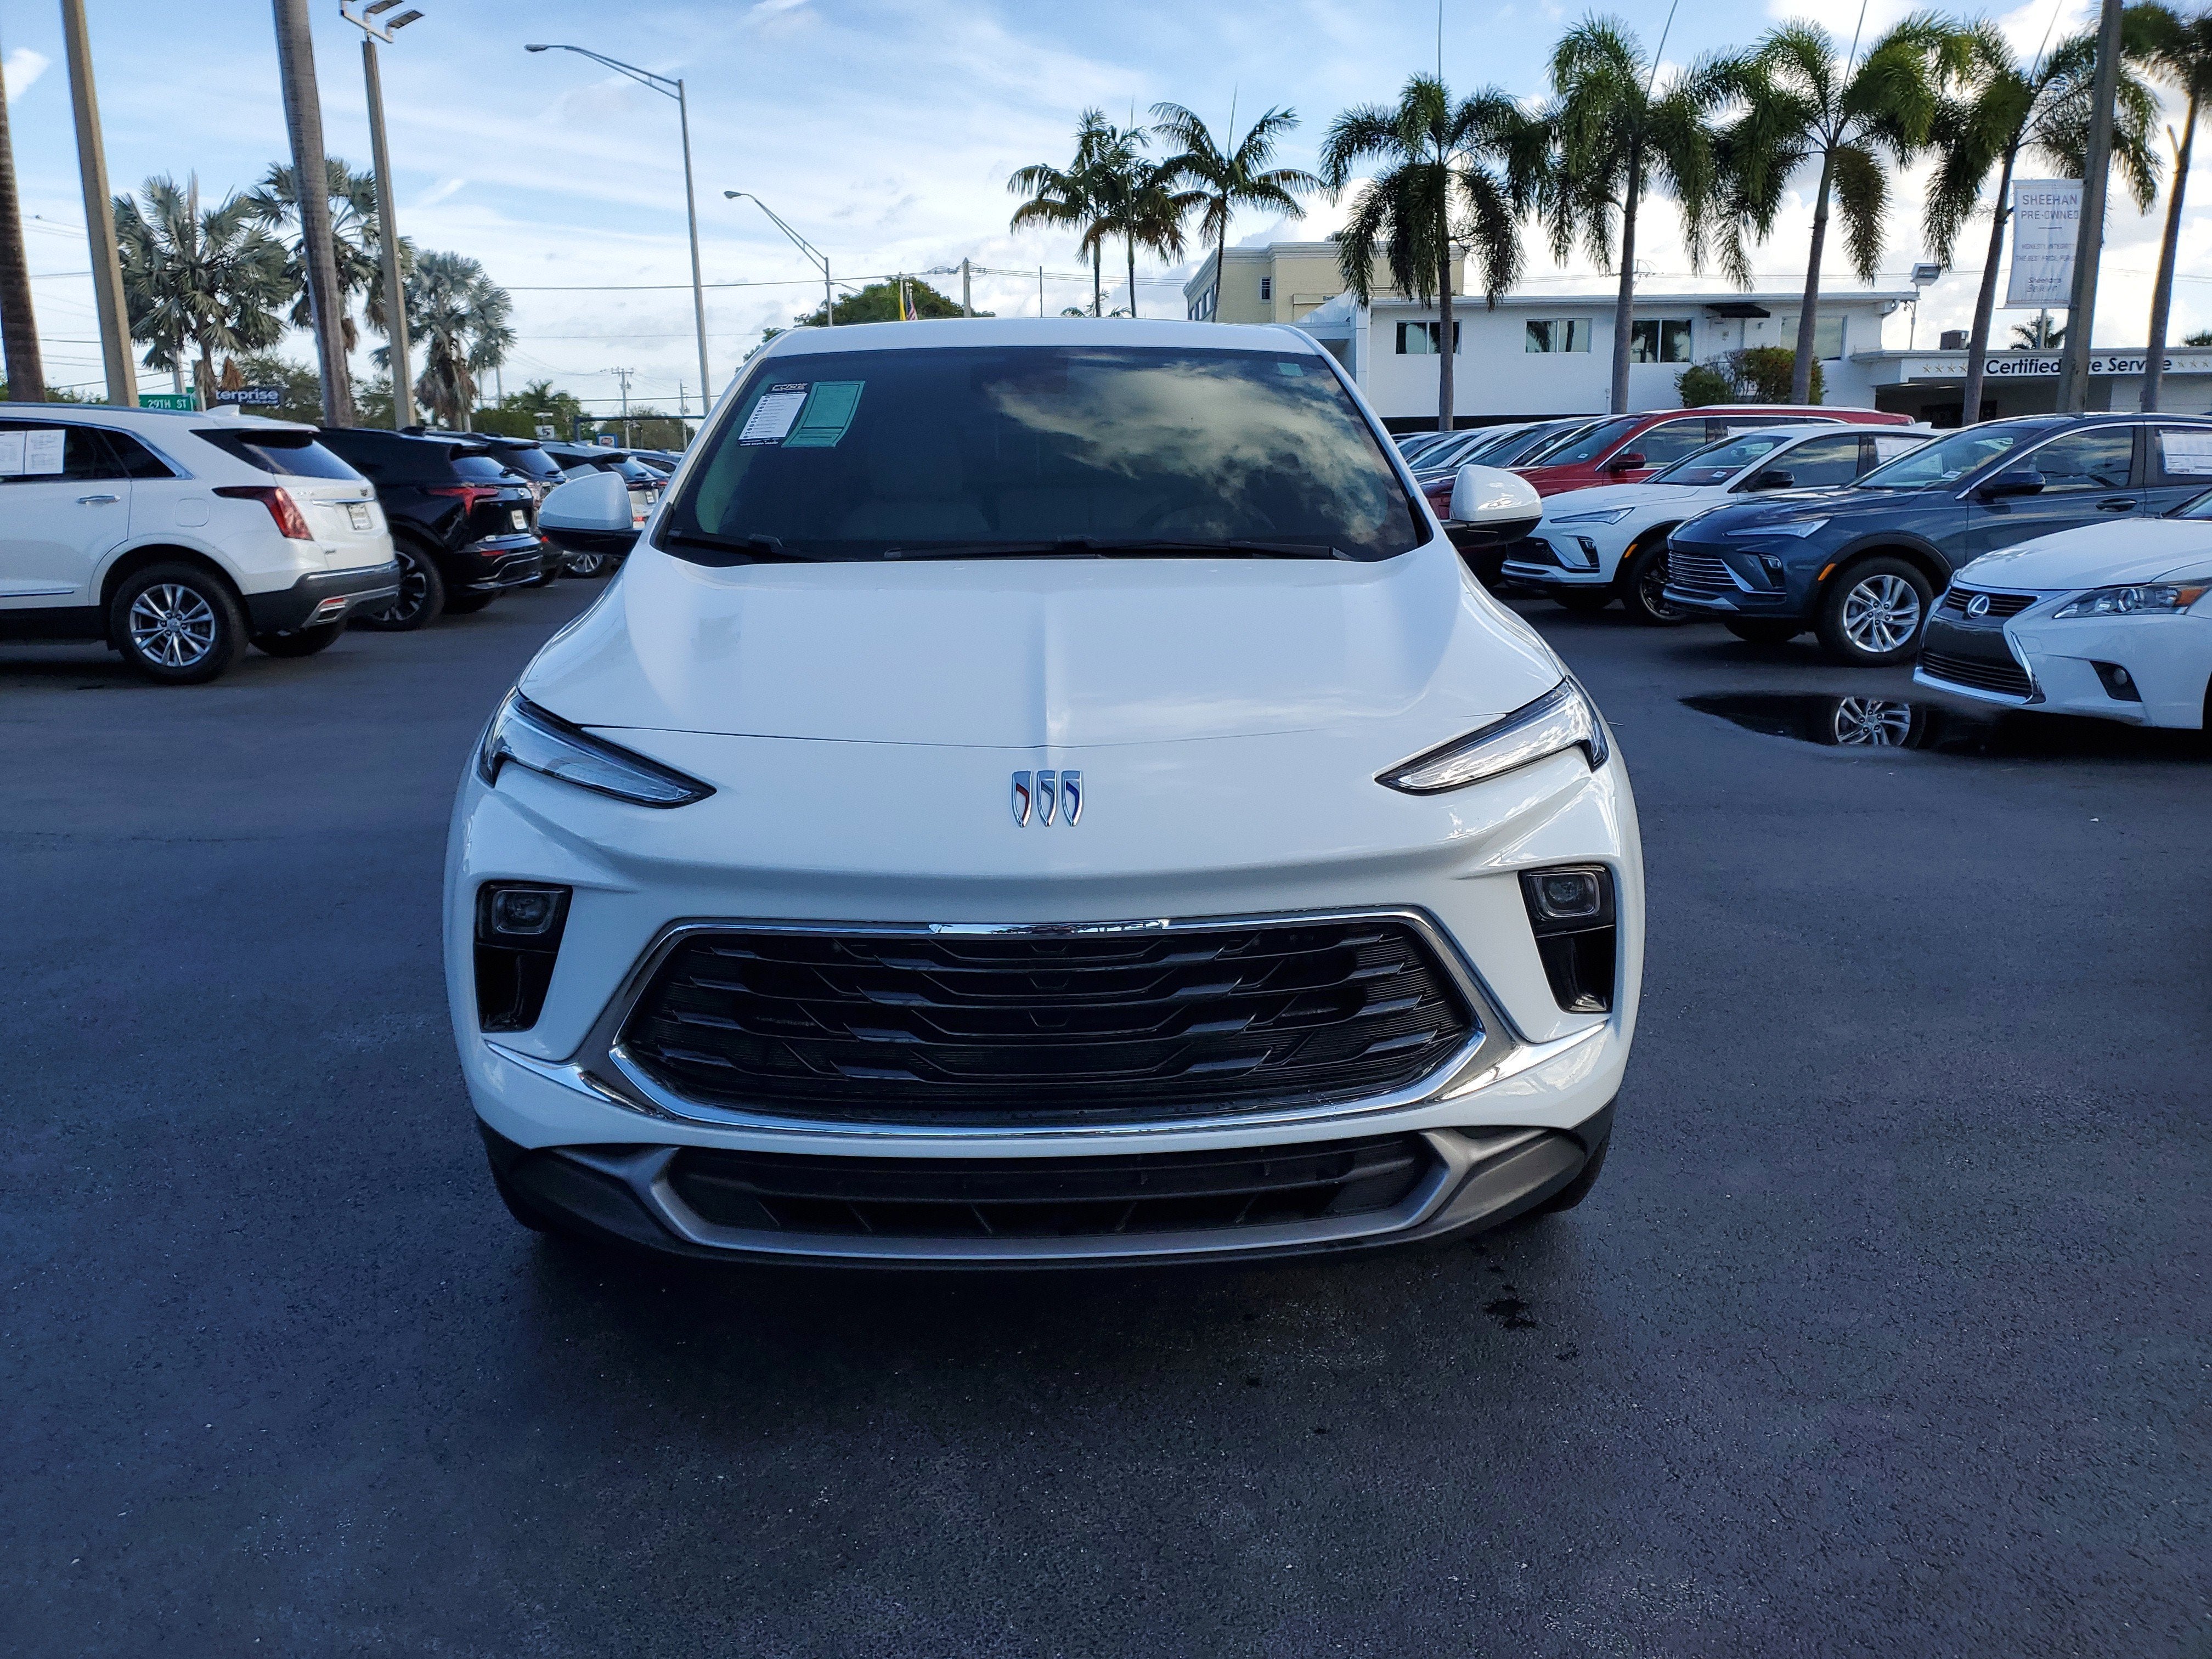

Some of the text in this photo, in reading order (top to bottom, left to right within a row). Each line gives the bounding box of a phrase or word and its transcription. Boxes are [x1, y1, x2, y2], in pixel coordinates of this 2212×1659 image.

[2022, 194, 2078, 205] SHEEHAN
[2021, 210, 2079, 219] PRE-OWNED
[1985, 358, 2061, 374] Certified
[2108, 357, 2172, 372] Serve
[216, 388, 279, 403] terprise
[147, 399, 171, 409] 29TH
[176, 399, 187, 409] ST
